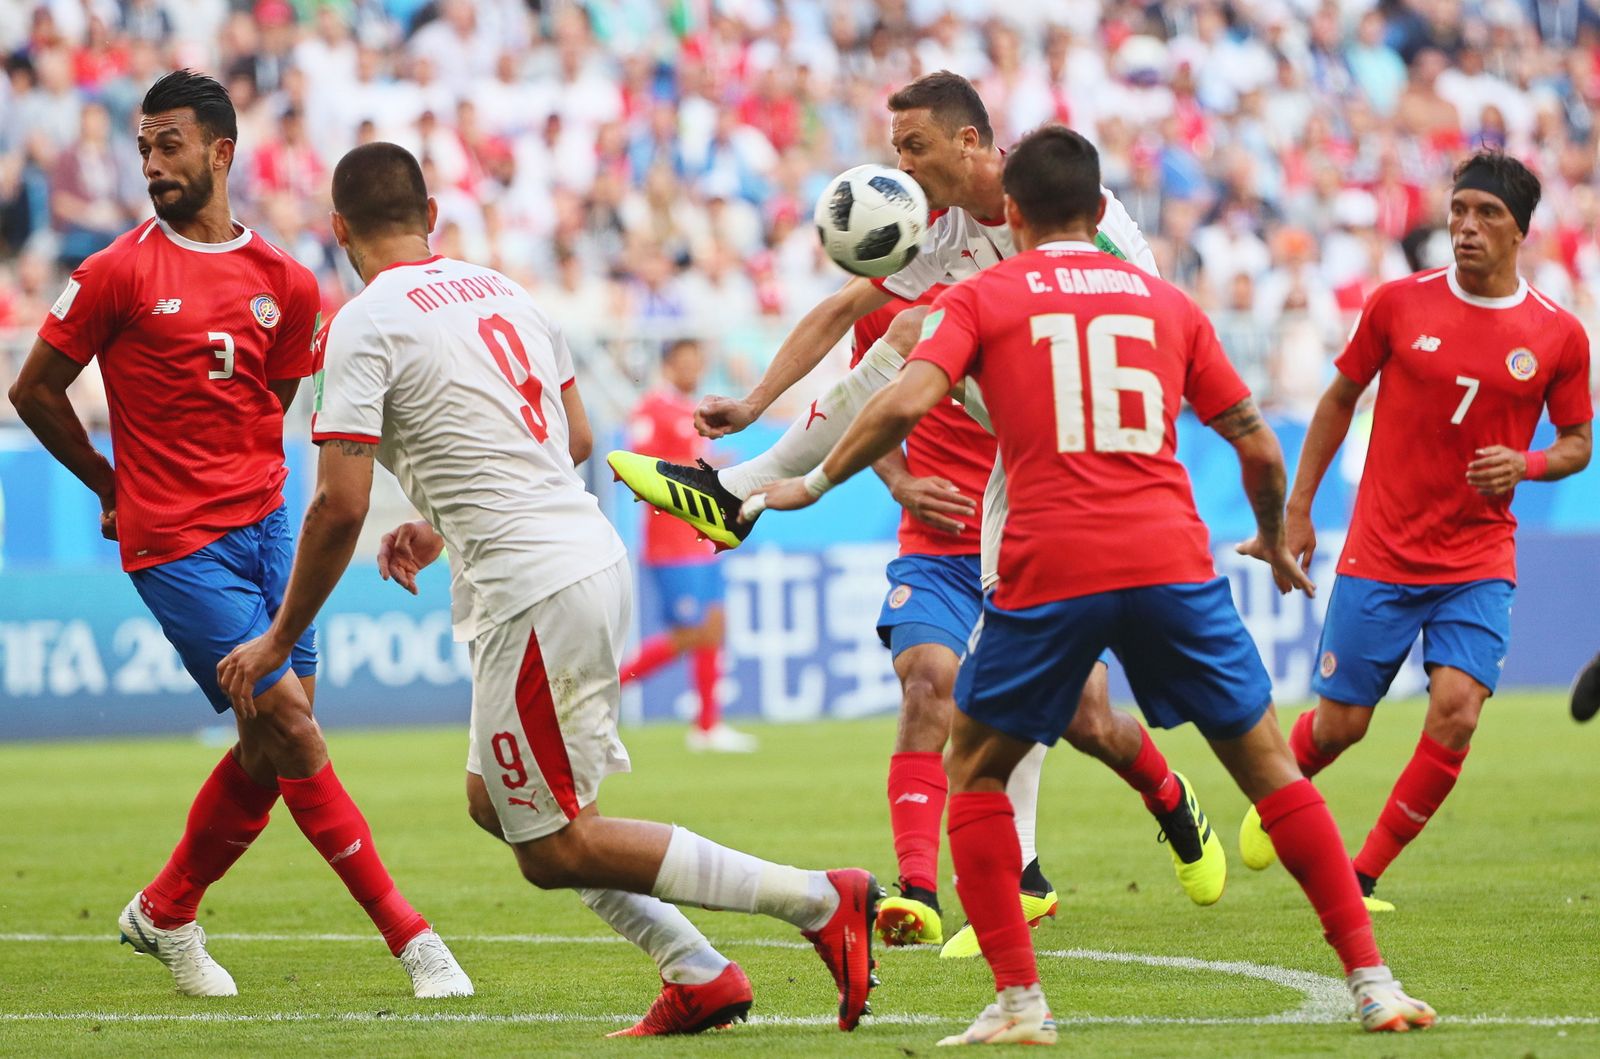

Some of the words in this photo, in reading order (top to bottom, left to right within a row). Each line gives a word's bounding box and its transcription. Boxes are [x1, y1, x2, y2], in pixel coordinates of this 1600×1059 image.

[1025, 270, 1053, 293] C.
[1054, 267, 1151, 297] GAMBOA
[208, 332, 234, 379] 3
[478, 313, 549, 443] 9
[1030, 313, 1165, 455] 16
[1451, 375, 1480, 424] 7
[491, 731, 528, 790] 9
